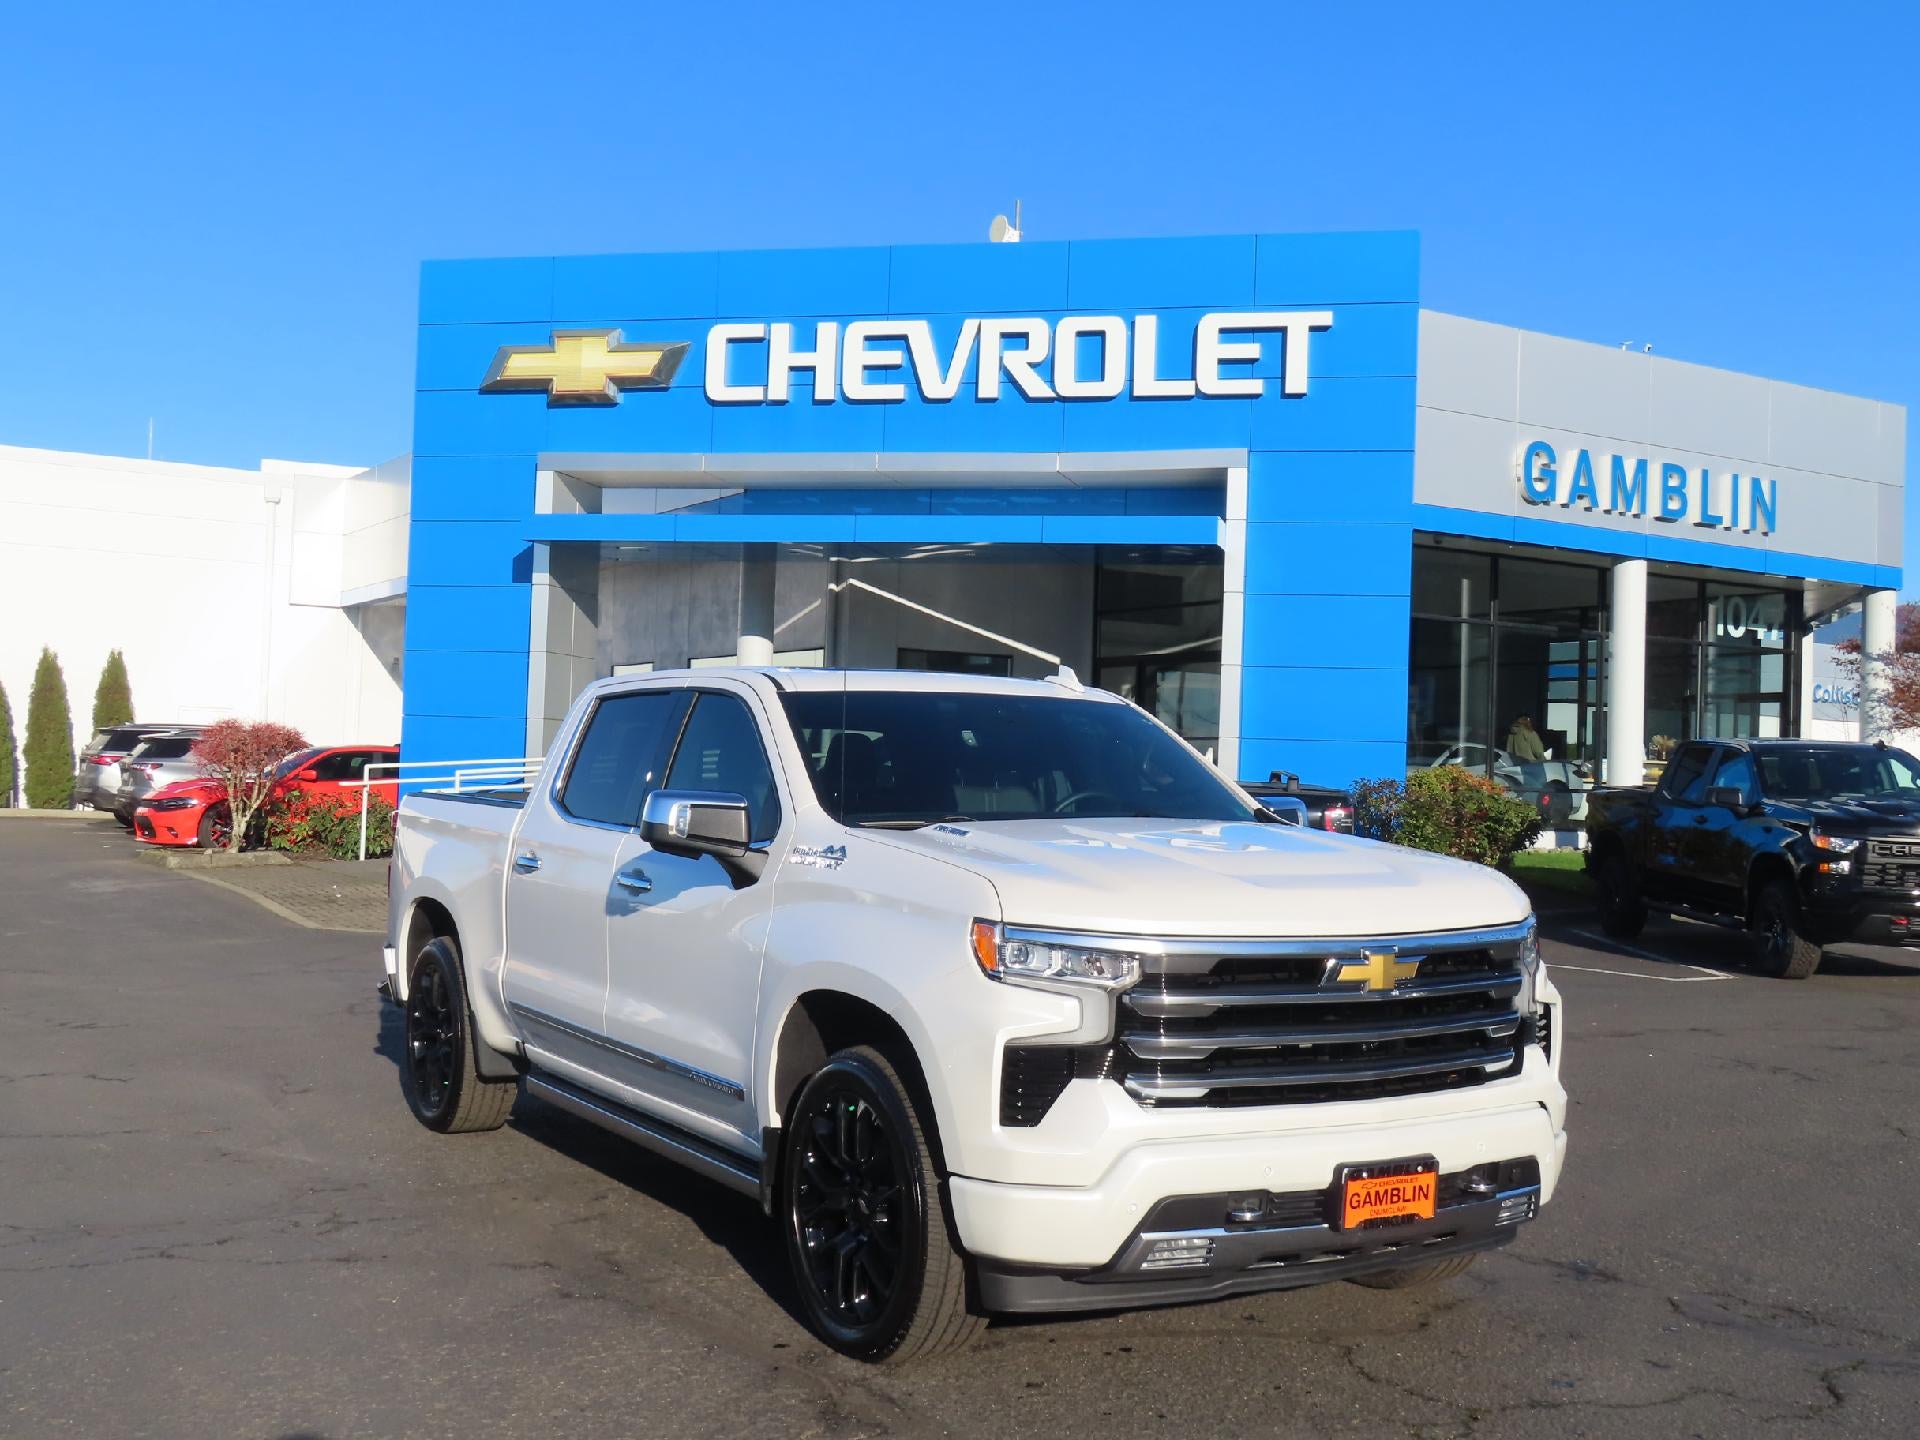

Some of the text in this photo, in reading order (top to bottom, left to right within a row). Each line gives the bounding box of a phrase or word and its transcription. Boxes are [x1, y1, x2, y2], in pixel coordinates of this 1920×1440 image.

[705, 310, 1333, 403] CHEVROLET
[1519, 440, 1777, 534] GAMBLIN
[1714, 595, 1784, 641] 1047
[1349, 1183, 1430, 1210] GAMBLIN
[1378, 1177, 1419, 1188] CHEVROLET
